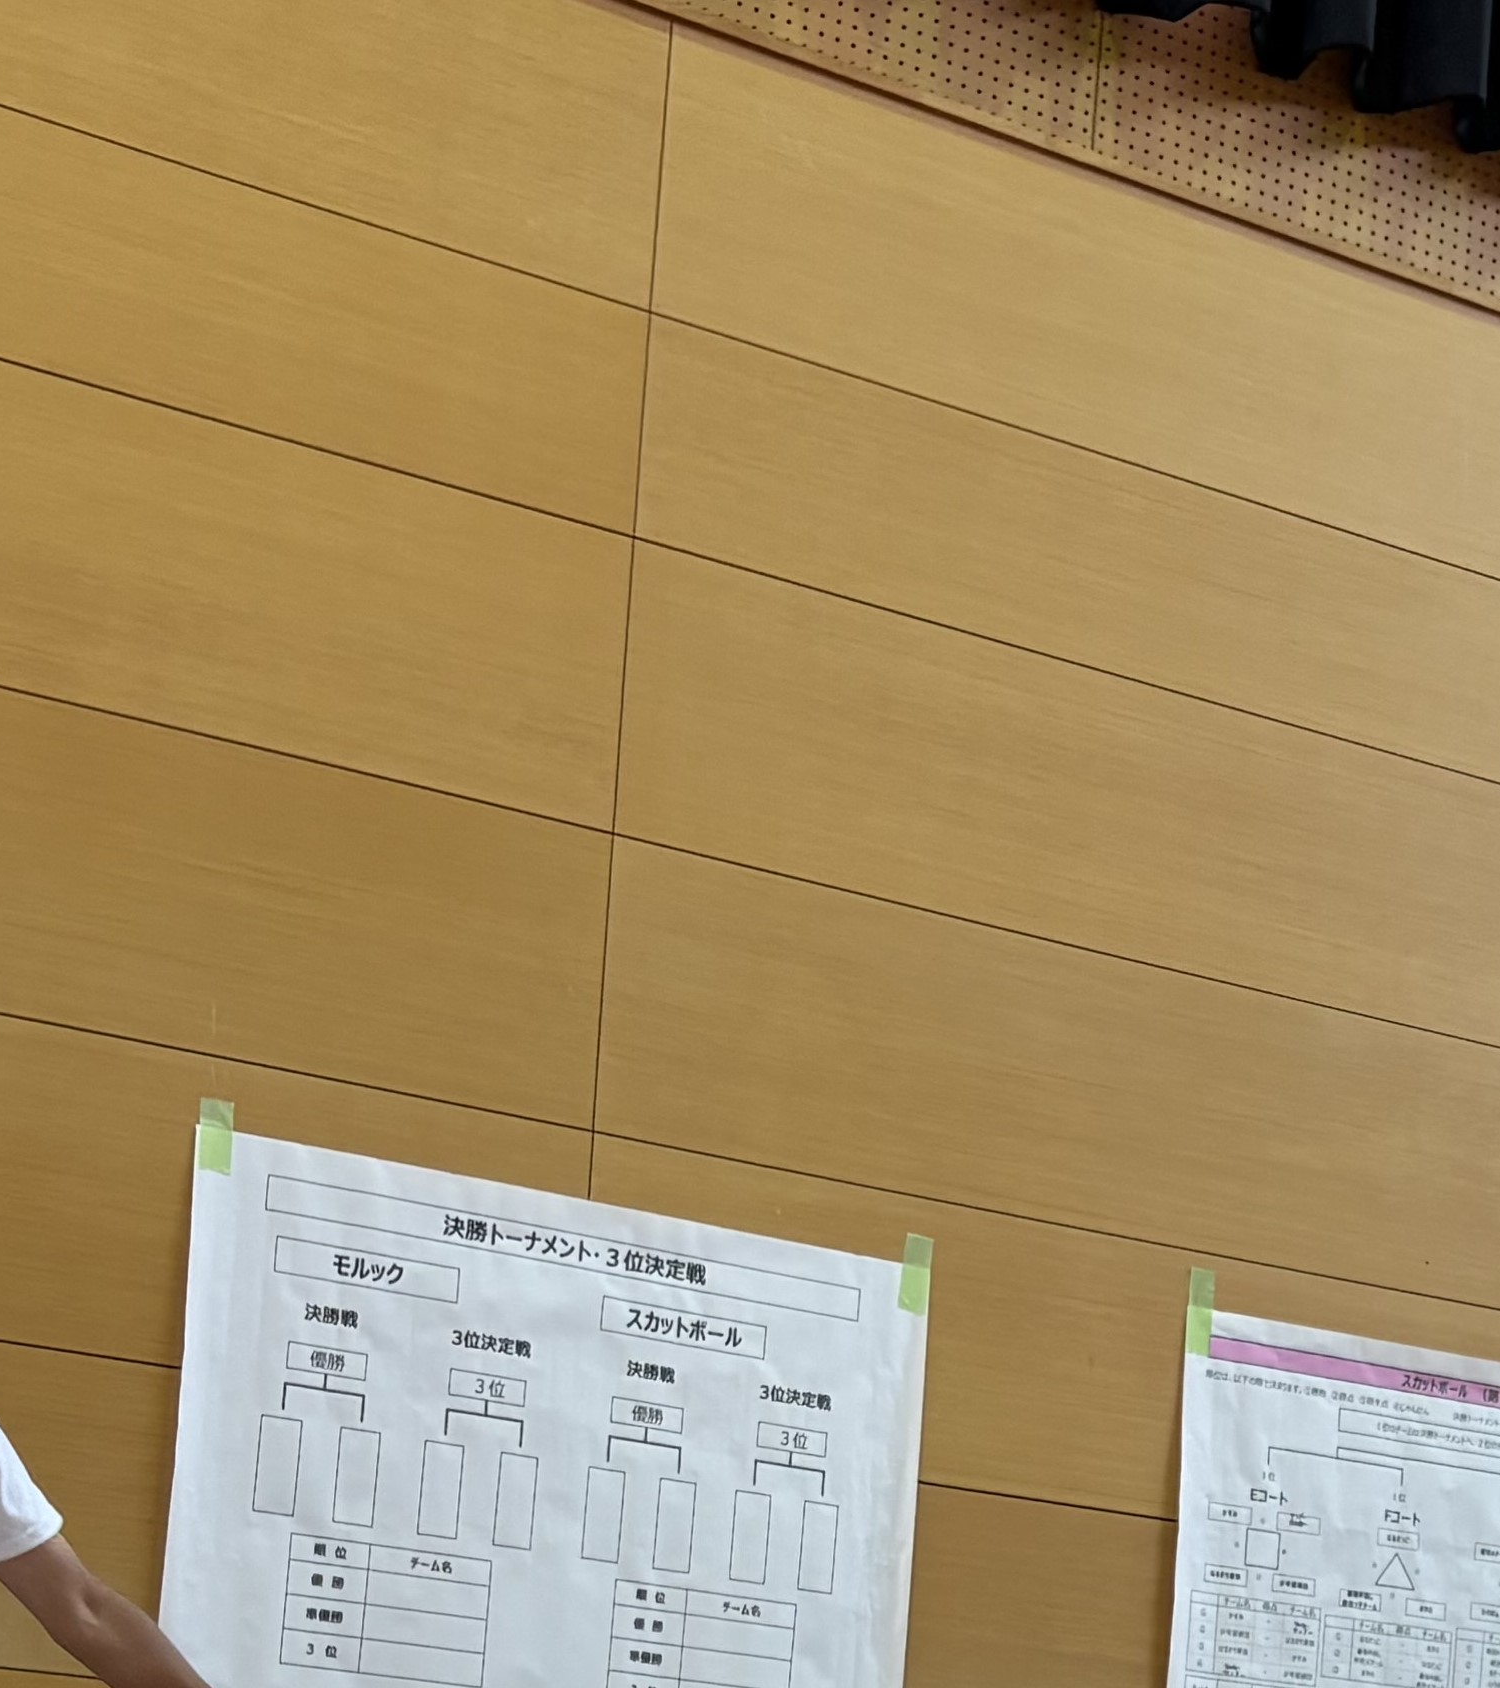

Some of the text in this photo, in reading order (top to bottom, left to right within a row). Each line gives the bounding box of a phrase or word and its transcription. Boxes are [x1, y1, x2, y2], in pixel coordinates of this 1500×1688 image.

[333, 1254, 404, 1285] モルック
[304, 1303, 359, 1329] 決勝戦
[626, 1308, 743, 1348] スカットボール
[451, 1330, 532, 1359] 3位決定戦
[310, 1351, 345, 1372] 優勝
[627, 1360, 676, 1384] 決勝戦
[1401, 1374, 1468, 1398] スカットボール
[759, 1385, 832, 1412] 3位決定戦
[632, 1405, 663, 1425] 優勝
[1250, 1488, 1288, 1506] Eコート
[1385, 1509, 1421, 1526] Fコート
